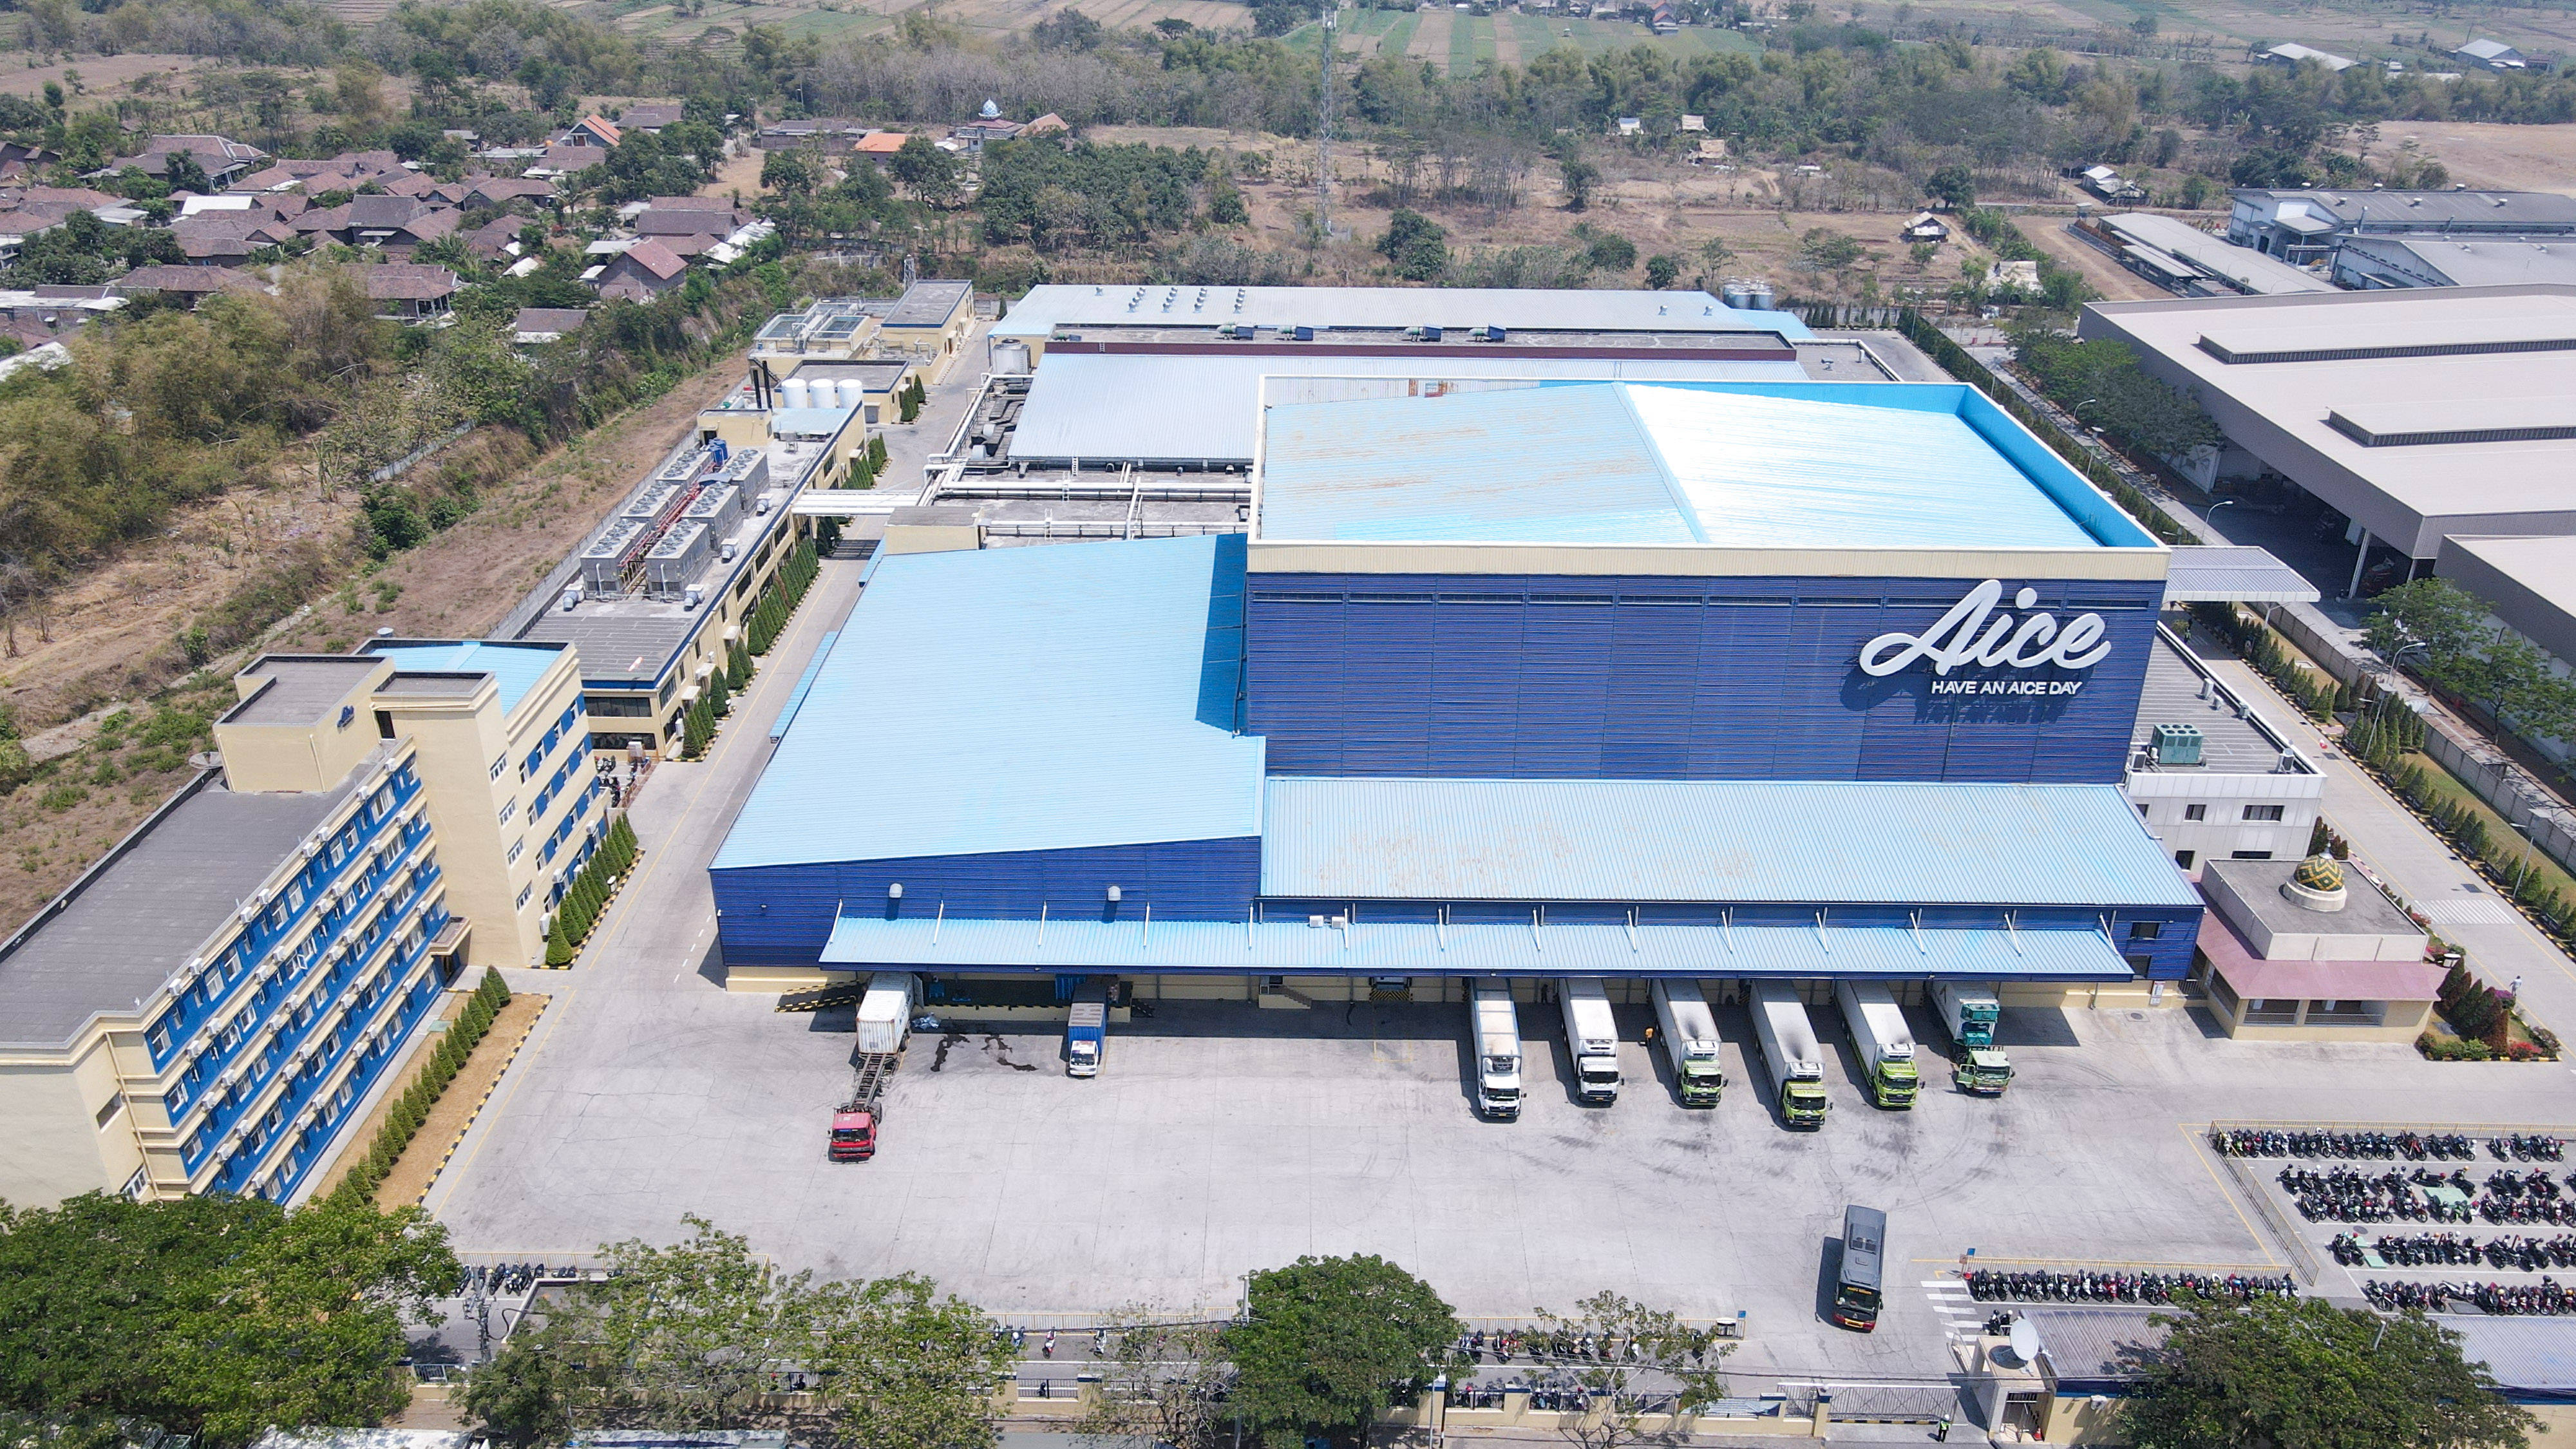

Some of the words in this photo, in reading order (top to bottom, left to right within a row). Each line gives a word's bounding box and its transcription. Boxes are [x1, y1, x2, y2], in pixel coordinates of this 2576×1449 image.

[1859, 579, 2112, 677] Aice
[1931, 680, 1978, 695] HAVE
[1979, 681, 2005, 695] AN
[2007, 681, 2047, 695] AICE
[2049, 681, 2083, 695] DAY
